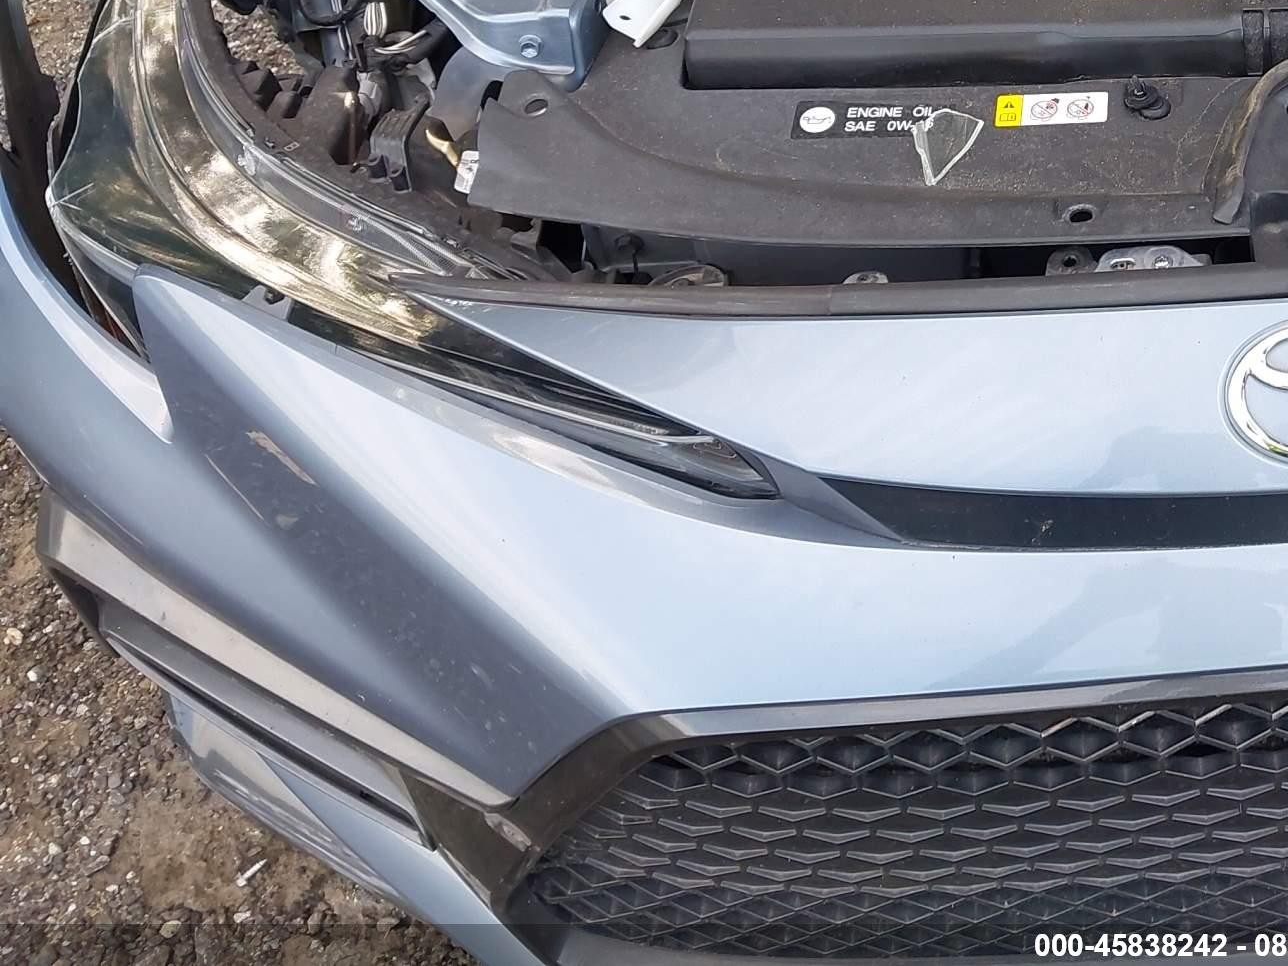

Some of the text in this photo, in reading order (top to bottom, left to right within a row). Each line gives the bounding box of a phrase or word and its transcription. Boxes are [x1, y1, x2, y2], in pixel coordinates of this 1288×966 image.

[847, 105, 934, 118] ENGINE OIL
[844, 120, 876, 132] SAE
